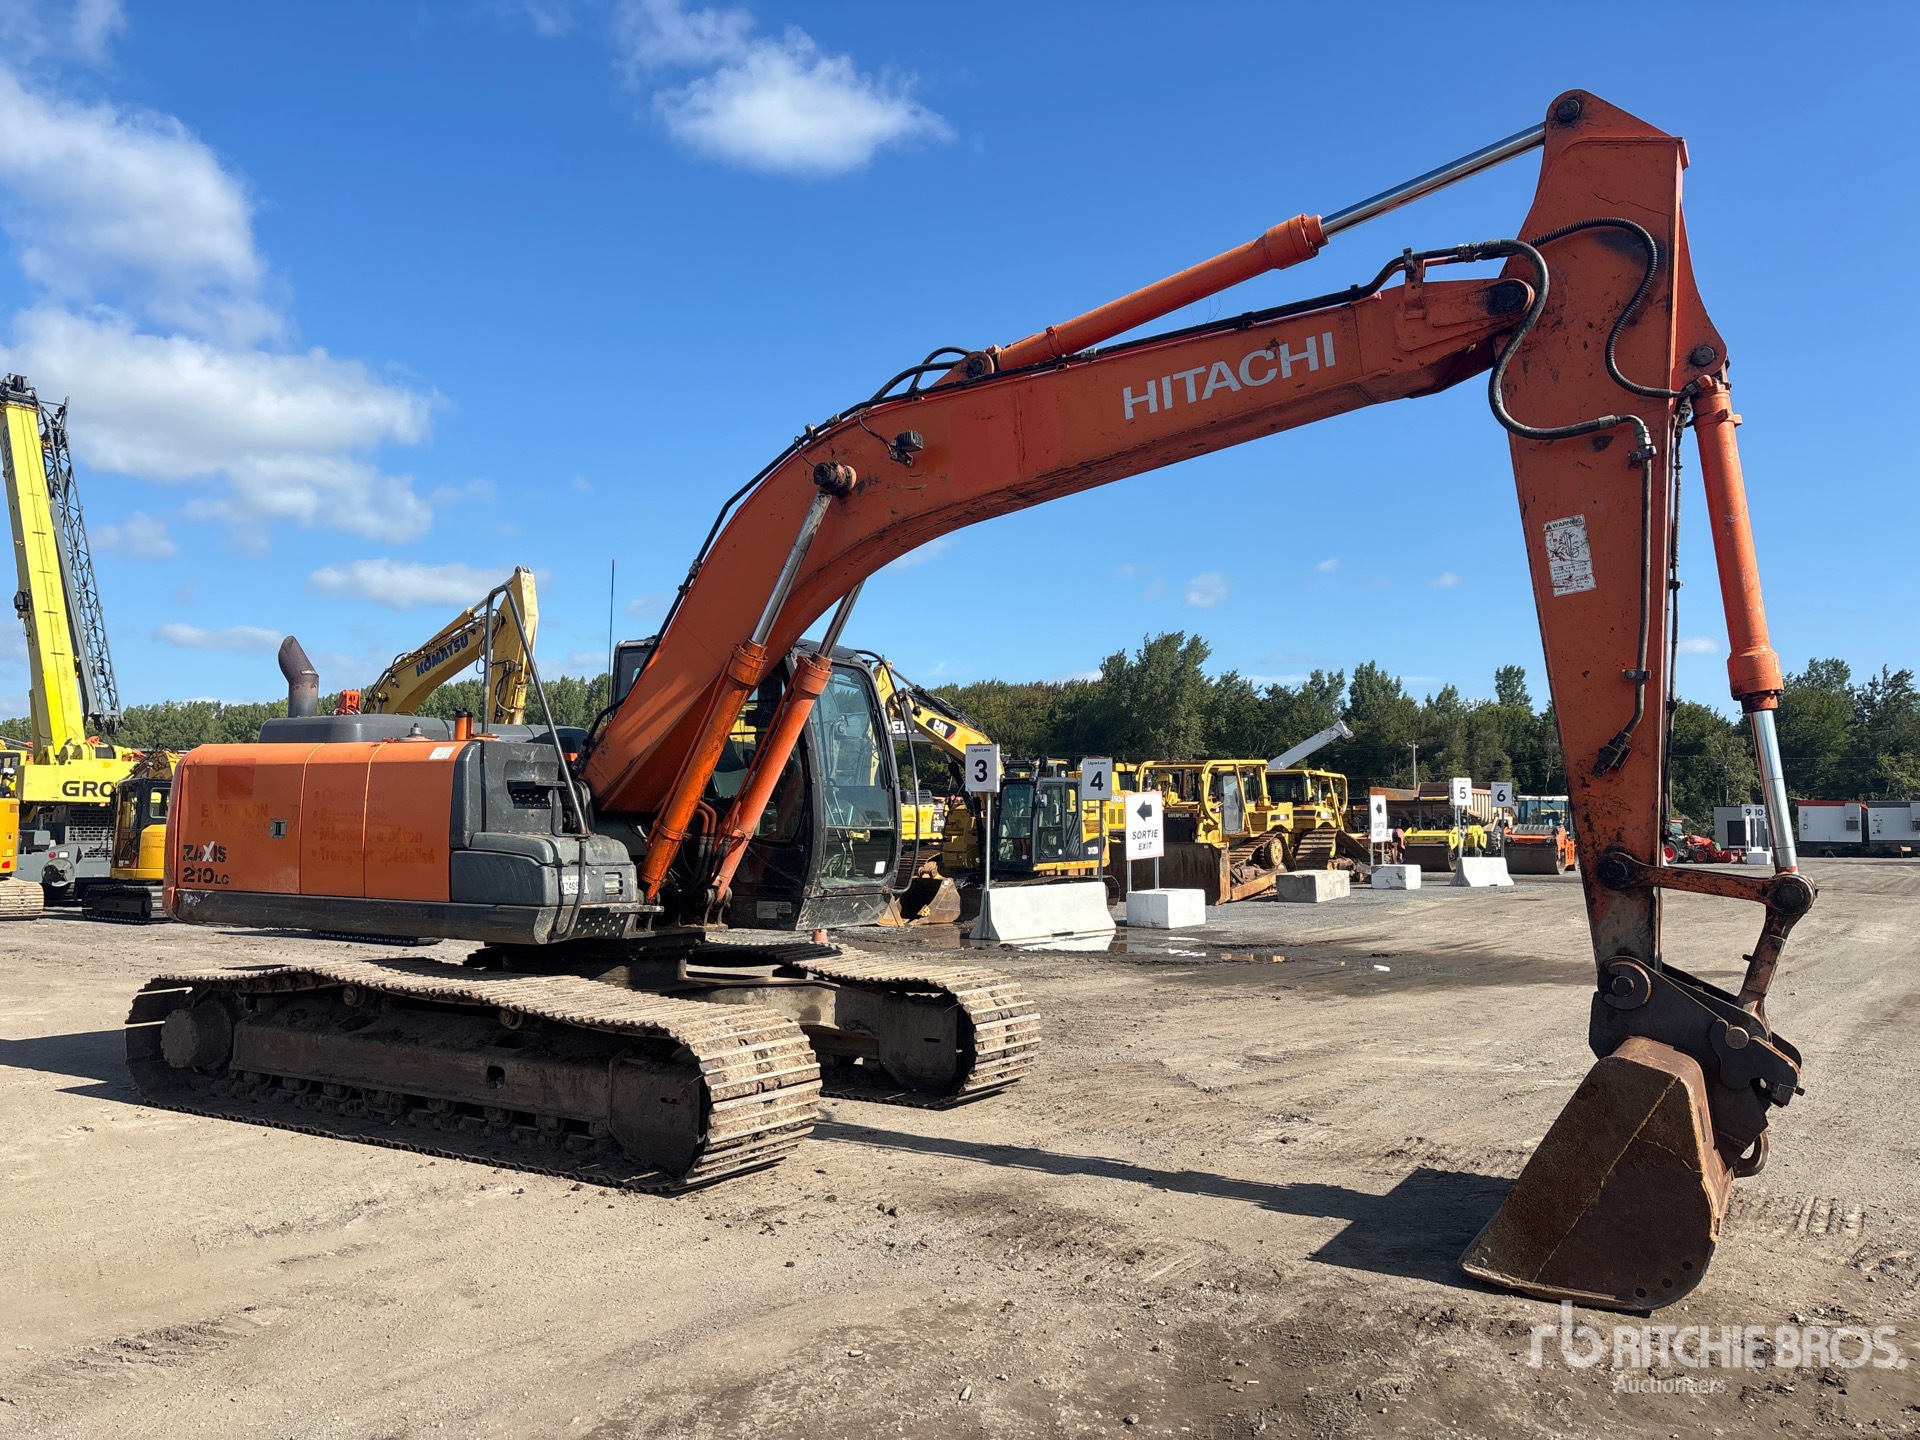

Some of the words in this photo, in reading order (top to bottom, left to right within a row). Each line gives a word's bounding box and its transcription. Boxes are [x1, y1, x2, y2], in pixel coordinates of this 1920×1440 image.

[1122, 331, 1336, 420] HITACHI
[1552, 517, 1583, 529] WARNING
[415, 633, 469, 678] KOMATSU
[932, 719, 949, 737] CAT
[974, 759, 988, 783] 3
[1090, 771, 1104, 791] 4
[1459, 786, 1467, 800] 5
[1497, 789, 1506, 802] 6
[1745, 808, 1752, 816] 9
[1754, 808, 1764, 816] 10
[1131, 829, 1159, 841] SORTIE
[183, 841, 227, 863] ZAXIS
[1138, 842, 1153, 851] EXIT
